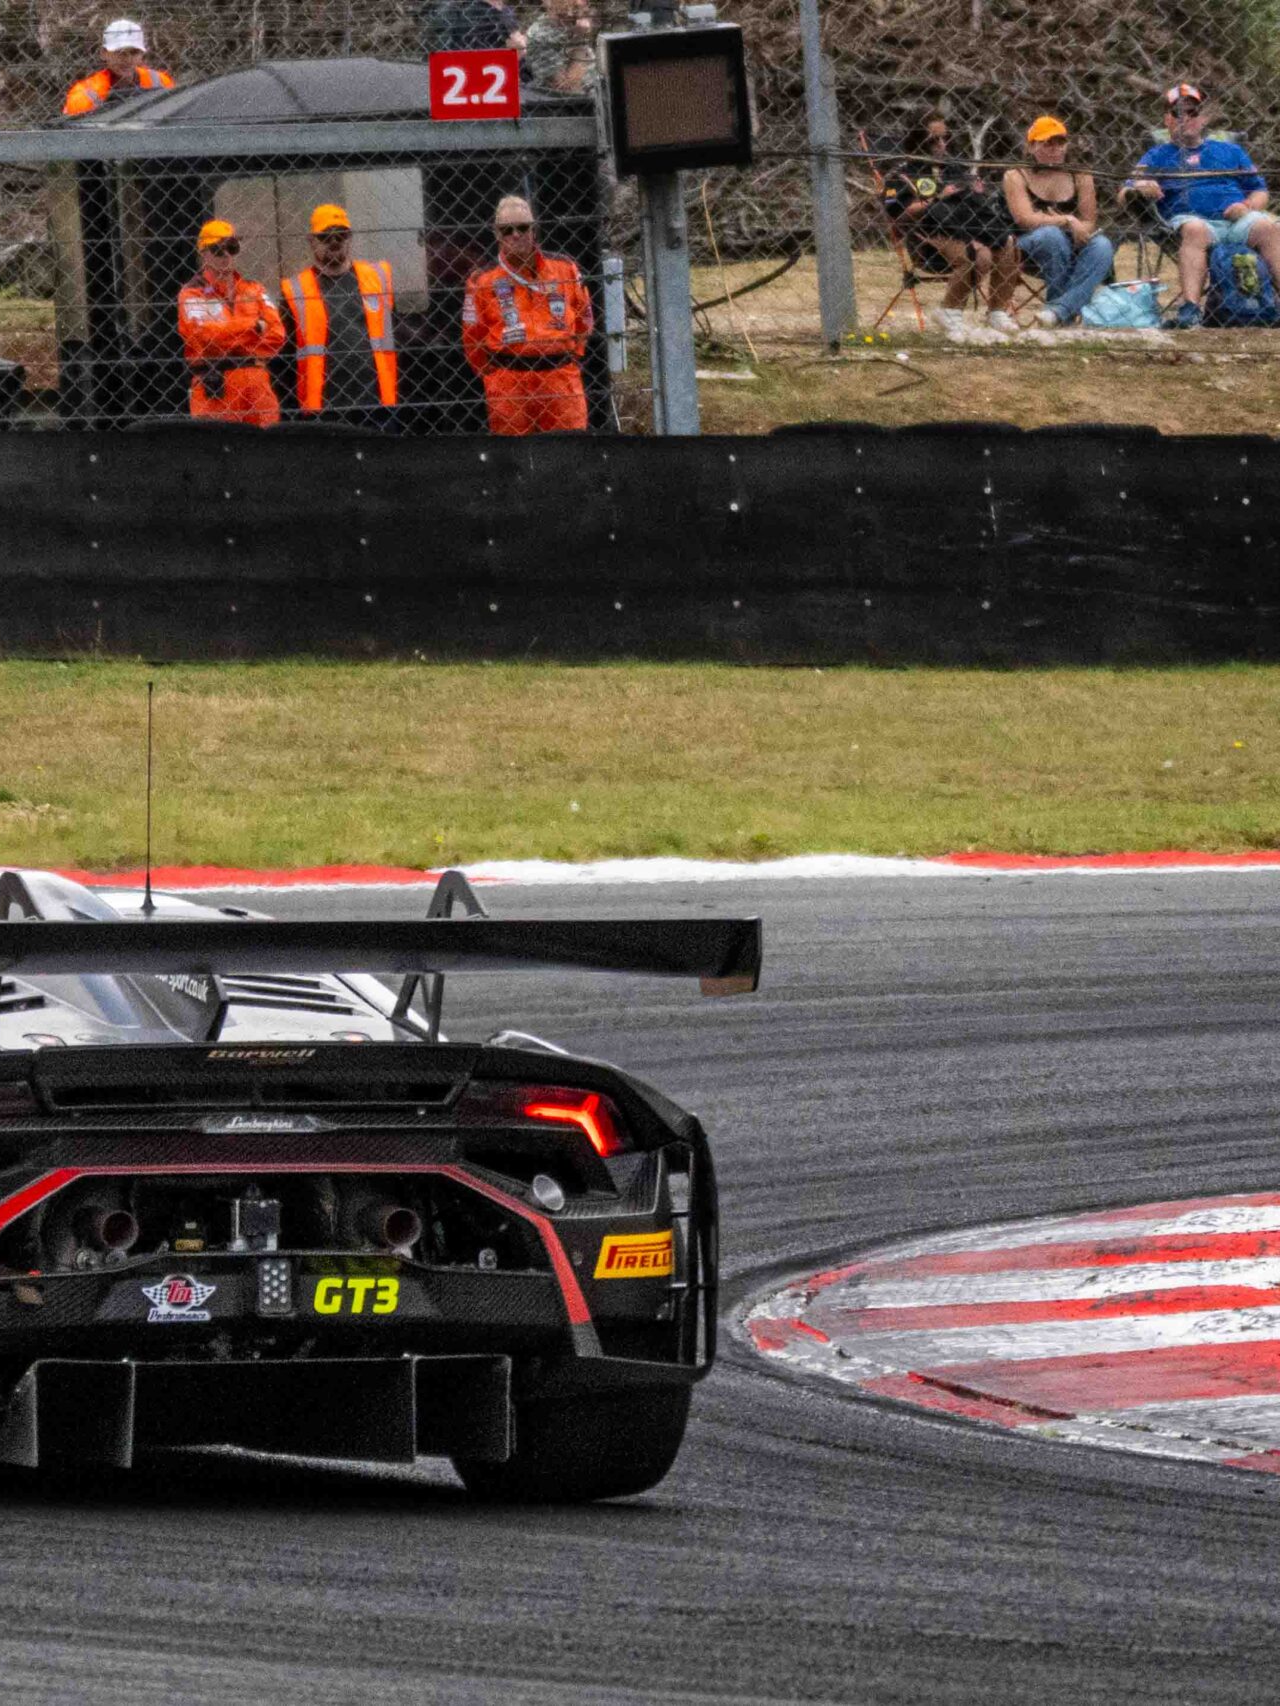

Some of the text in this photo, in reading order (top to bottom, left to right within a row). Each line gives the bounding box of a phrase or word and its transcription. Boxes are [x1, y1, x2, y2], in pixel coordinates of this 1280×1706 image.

[443, 65, 507, 105] 2.2
[207, 1048, 317, 1059] Barwell
[225, 1116, 294, 1132] Lamborghini
[313, 1277, 400, 1315] GT3
